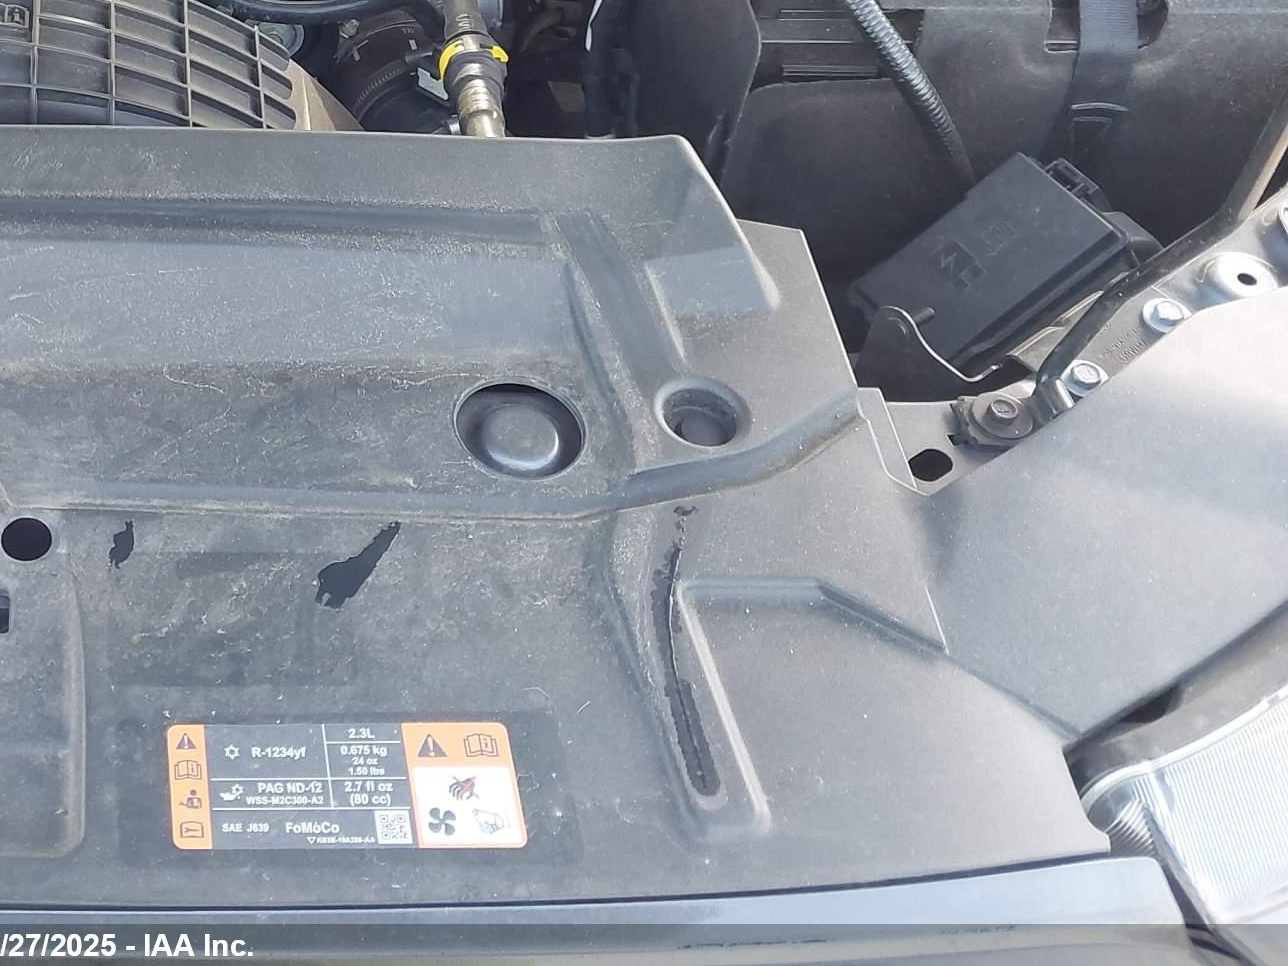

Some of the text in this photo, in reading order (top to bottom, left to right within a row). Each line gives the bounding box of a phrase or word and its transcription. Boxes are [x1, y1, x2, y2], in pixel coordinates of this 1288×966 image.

[347, 727, 376, 739] 2.3L
[251, 746, 306, 760] R-1234yf
[340, 745, 388, 757] 0.675 kg
[352, 756, 379, 766] 24 oz
[257, 782, 323, 793] PAG ND-12
[344, 781, 394, 792] 2.7 fl oz
[349, 793, 392, 806] (80 cc)
[222, 822, 269, 833] SAE J639
[285, 822, 340, 834] FoMoCo
